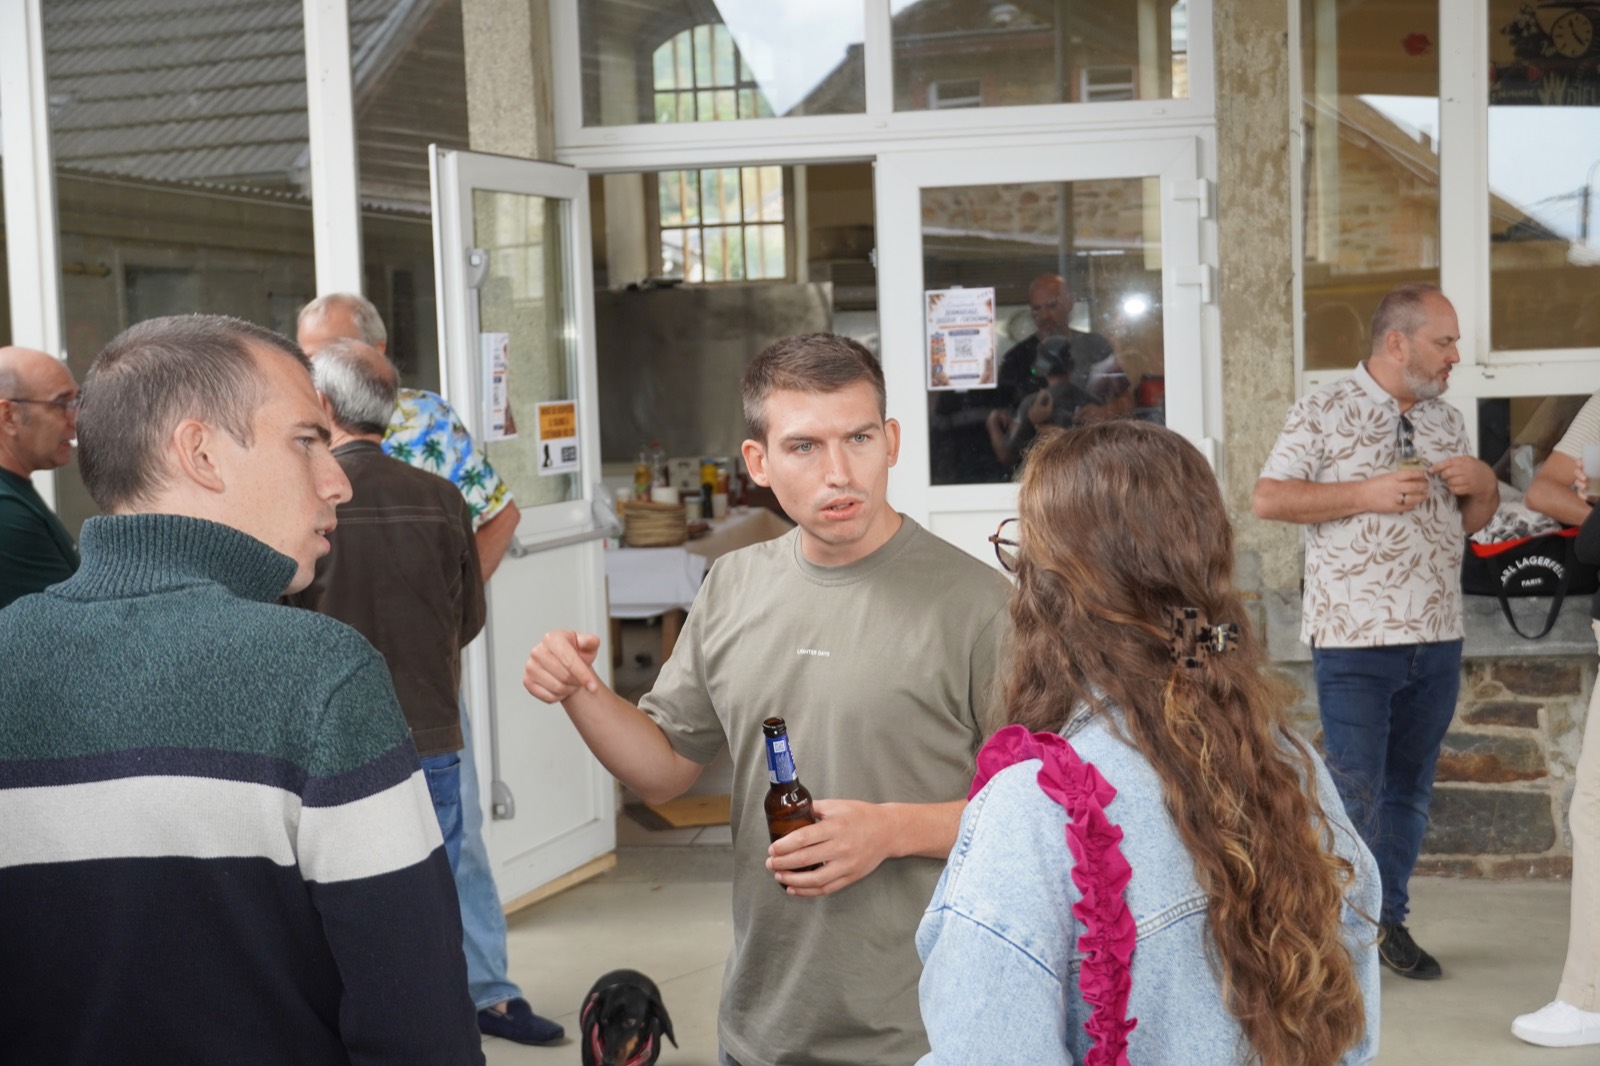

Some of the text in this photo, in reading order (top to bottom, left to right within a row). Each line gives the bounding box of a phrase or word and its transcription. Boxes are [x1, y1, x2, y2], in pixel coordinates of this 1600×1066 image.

[1500, 556, 1564, 587] ARL LAGERFEL
[1521, 577, 1542, 588] PARIS
